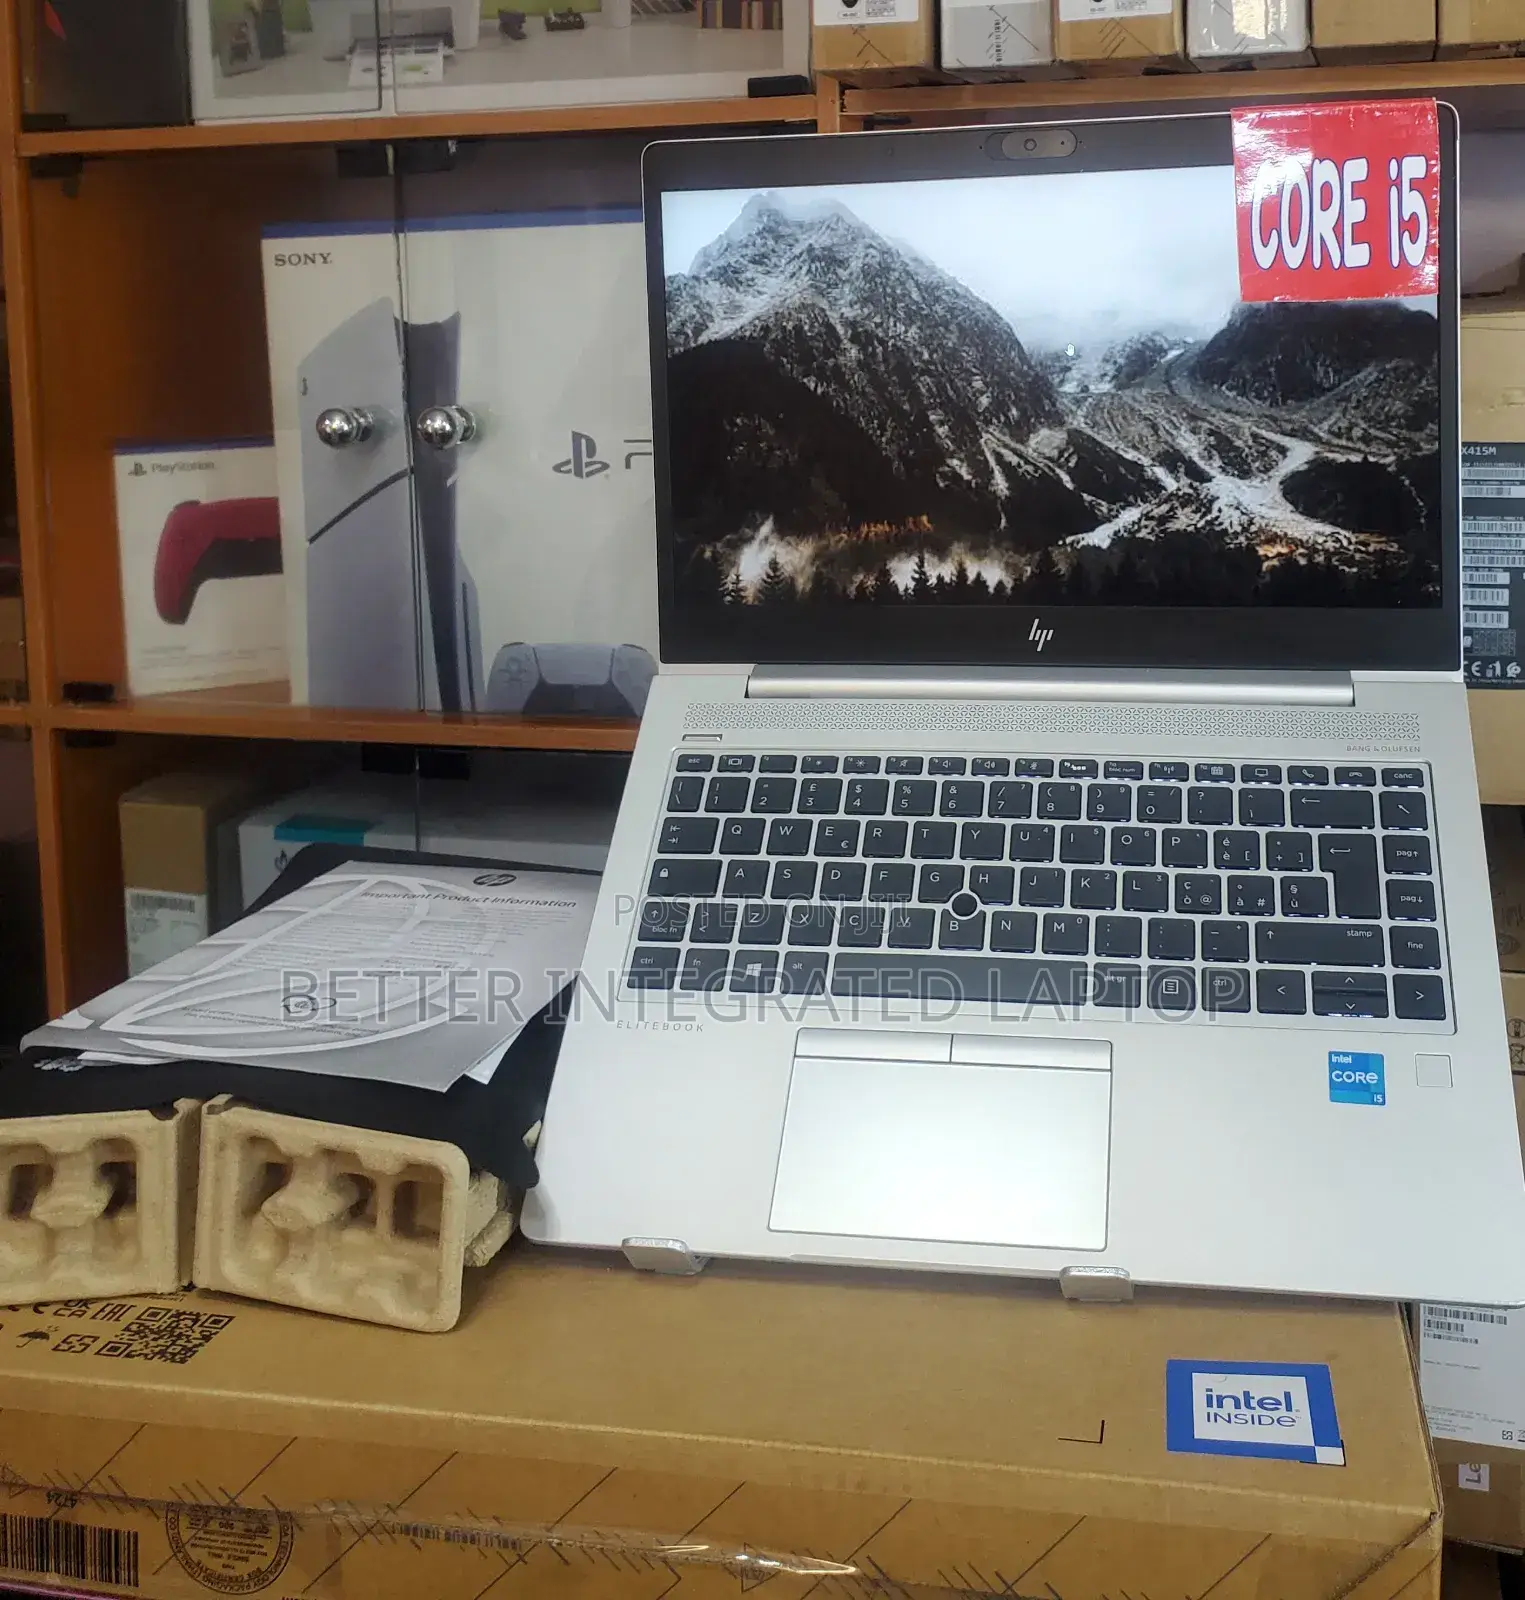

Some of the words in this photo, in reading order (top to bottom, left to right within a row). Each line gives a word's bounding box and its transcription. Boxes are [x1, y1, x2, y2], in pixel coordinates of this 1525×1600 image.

[1252, 155, 1371, 271] CORE
[1389, 155, 1429, 268] i5
[274, 252, 331, 267] SONY
[152, 461, 215, 475] PlayStation
[1346, 745, 1371, 753] BANG
[1380, 746, 1421, 754] OLUFSEN
[759, 796, 768, 805] 2
[806, 797, 814, 806] 3
[852, 798, 861, 807] 4
[900, 799, 909, 808] 5
[948, 800, 957, 809] 6
[997, 801, 1005, 810] 7
[1046, 803, 1055, 812] 8
[1096, 804, 1105, 813] 9
[731, 824, 742, 835] Q
[779, 825, 793, 836] W
[825, 826, 835, 836] E
[872, 827, 883, 838] R
[920, 828, 930, 839] T
[971, 829, 981, 840] Y
[1020, 831, 1030, 841] U
[1121, 834, 1133, 845] O
[1171, 836, 1181, 847] P
[1396, 850, 1412, 858] pag
[735, 867, 745, 878] A
[782, 868, 792, 879] S
[830, 869, 841, 880] D
[879, 870, 888, 881] F
[929, 872, 940, 882] G
[979, 873, 989, 884] H
[1029, 875, 1037, 886] J
[1080, 877, 1091, 888] K
[1132, 880, 1141, 890] L
[361, 891, 431, 900] Important
[433, 892, 491, 904] Product
[492, 896, 578, 908] Information
[750, 912, 760, 923] Z
[799, 913, 809, 924] X
[848, 914, 860, 926] C
[949, 920, 960, 931] B
[1001, 920, 1012, 931] N
[1053, 922, 1065, 933] M
[1346, 929, 1373, 938] stamp
[1407, 941, 1424, 949] fine
[640, 957, 654, 965] ctrl
[615, 1019, 705, 1033] ELITEBOOK
[1373, 1093, 1384, 1103] i5
[1205, 1387, 1293, 1412] intel
